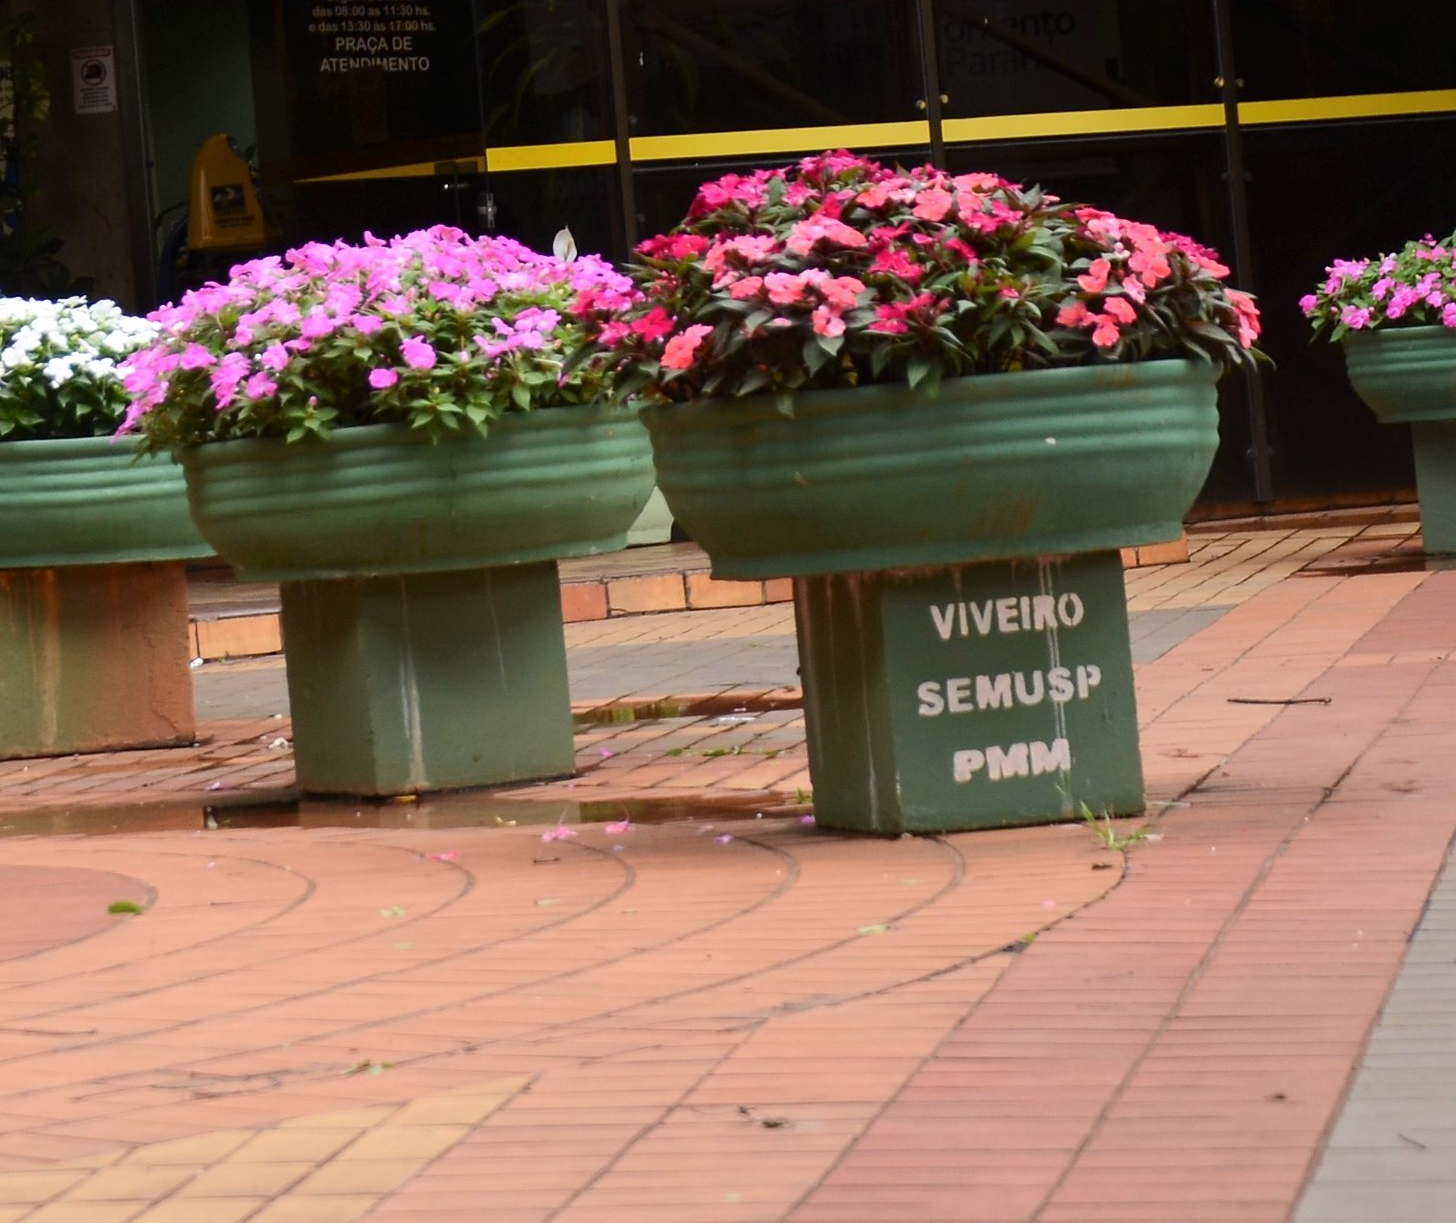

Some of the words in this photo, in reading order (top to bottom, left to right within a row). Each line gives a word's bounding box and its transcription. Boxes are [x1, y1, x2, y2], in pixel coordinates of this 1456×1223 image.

[308, 23, 315, 33] e
[318, 20, 339, 33] das
[341, 20, 371, 33] 13:30
[389, 20, 419, 32] 17:00
[312, 5, 333, 17] das
[335, 5, 366, 17] 08:00
[383, 5, 413, 17] 11:30
[335, 36, 389, 55] PRAÇA
[392, 36, 414, 52] DE
[930, 592, 1085, 640] VIVEIRO
[917, 665, 1102, 716] SEMUSP
[953, 738, 1071, 783] PMM
